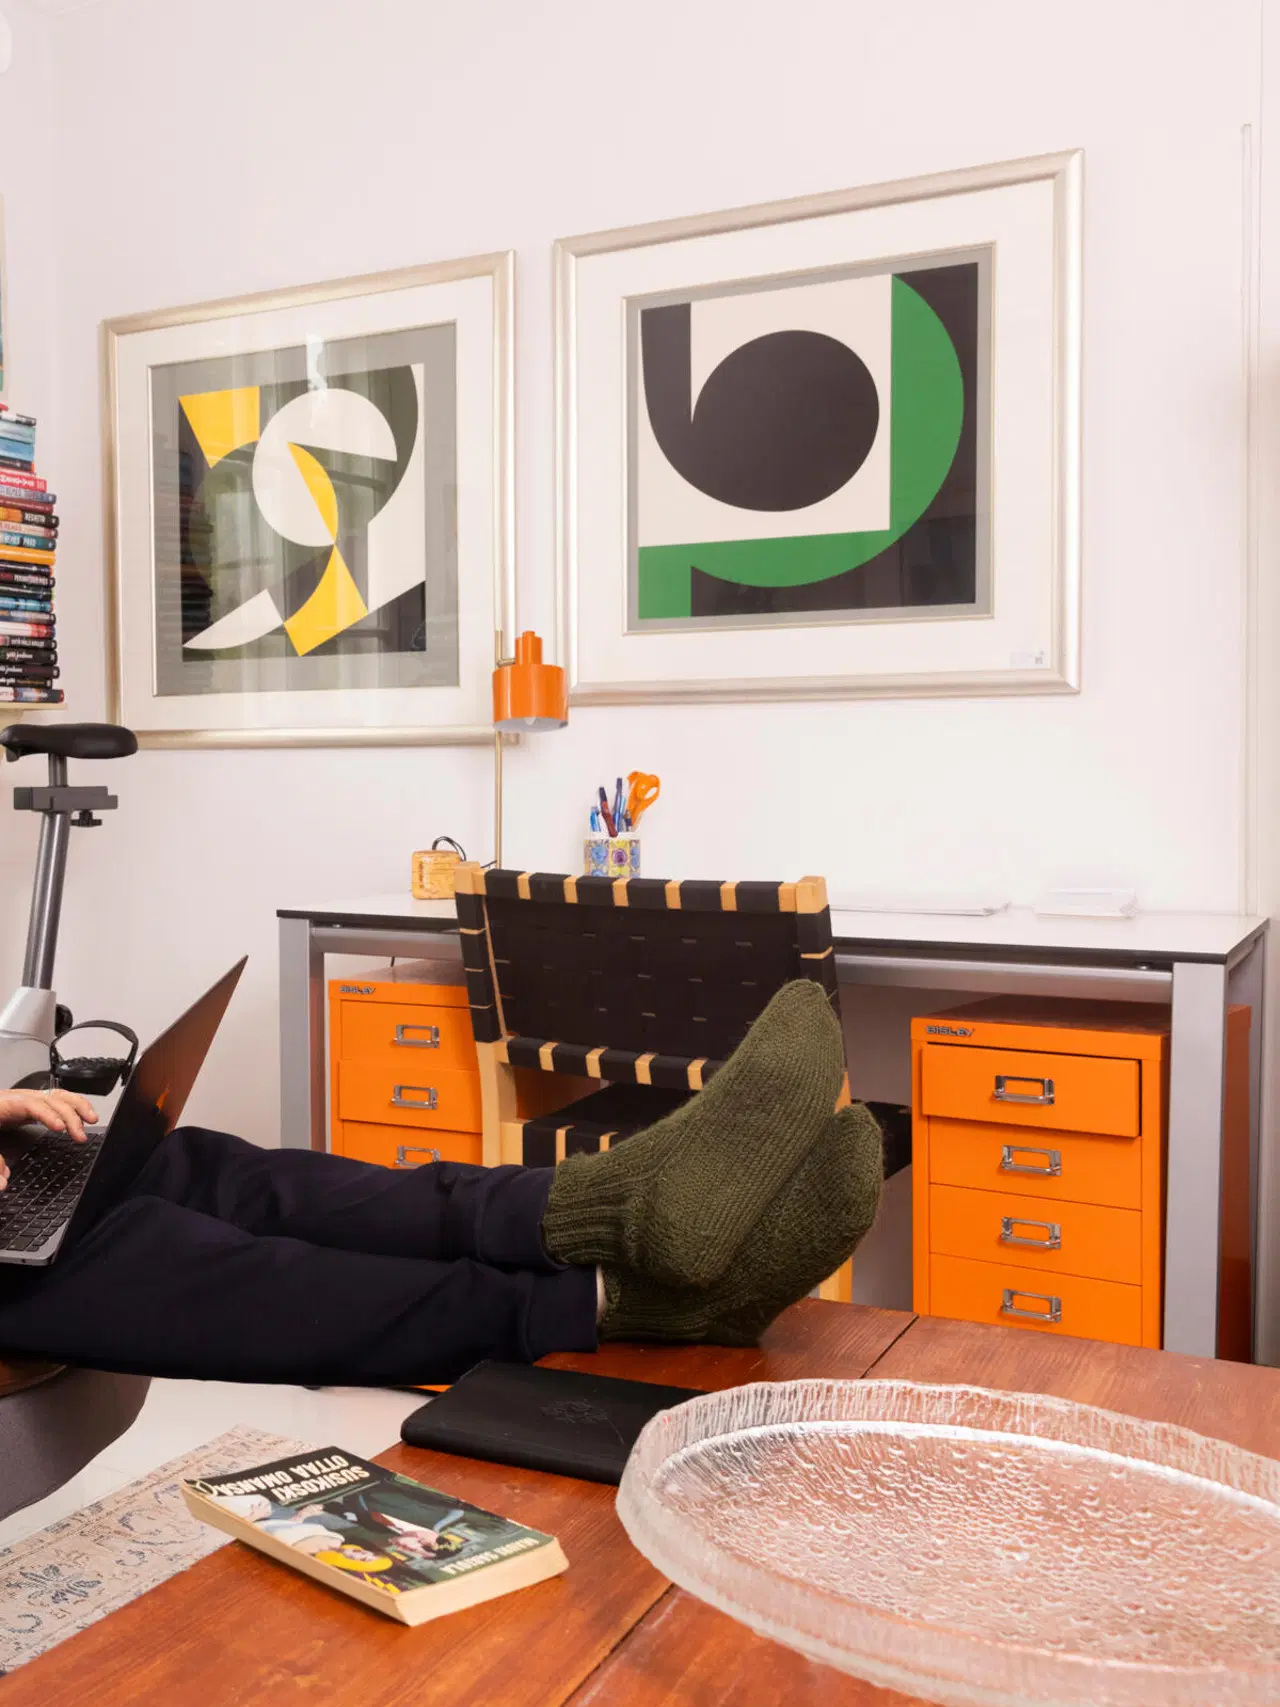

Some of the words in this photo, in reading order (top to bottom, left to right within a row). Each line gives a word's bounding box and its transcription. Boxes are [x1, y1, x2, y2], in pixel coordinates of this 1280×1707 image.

[926, 1025, 975, 1037] BISLEY
[289, 1454, 349, 1478] OTTAA
[213, 1470, 293, 1496] OMANSA
[270, 1465, 370, 1502] SUSIKOSKI
